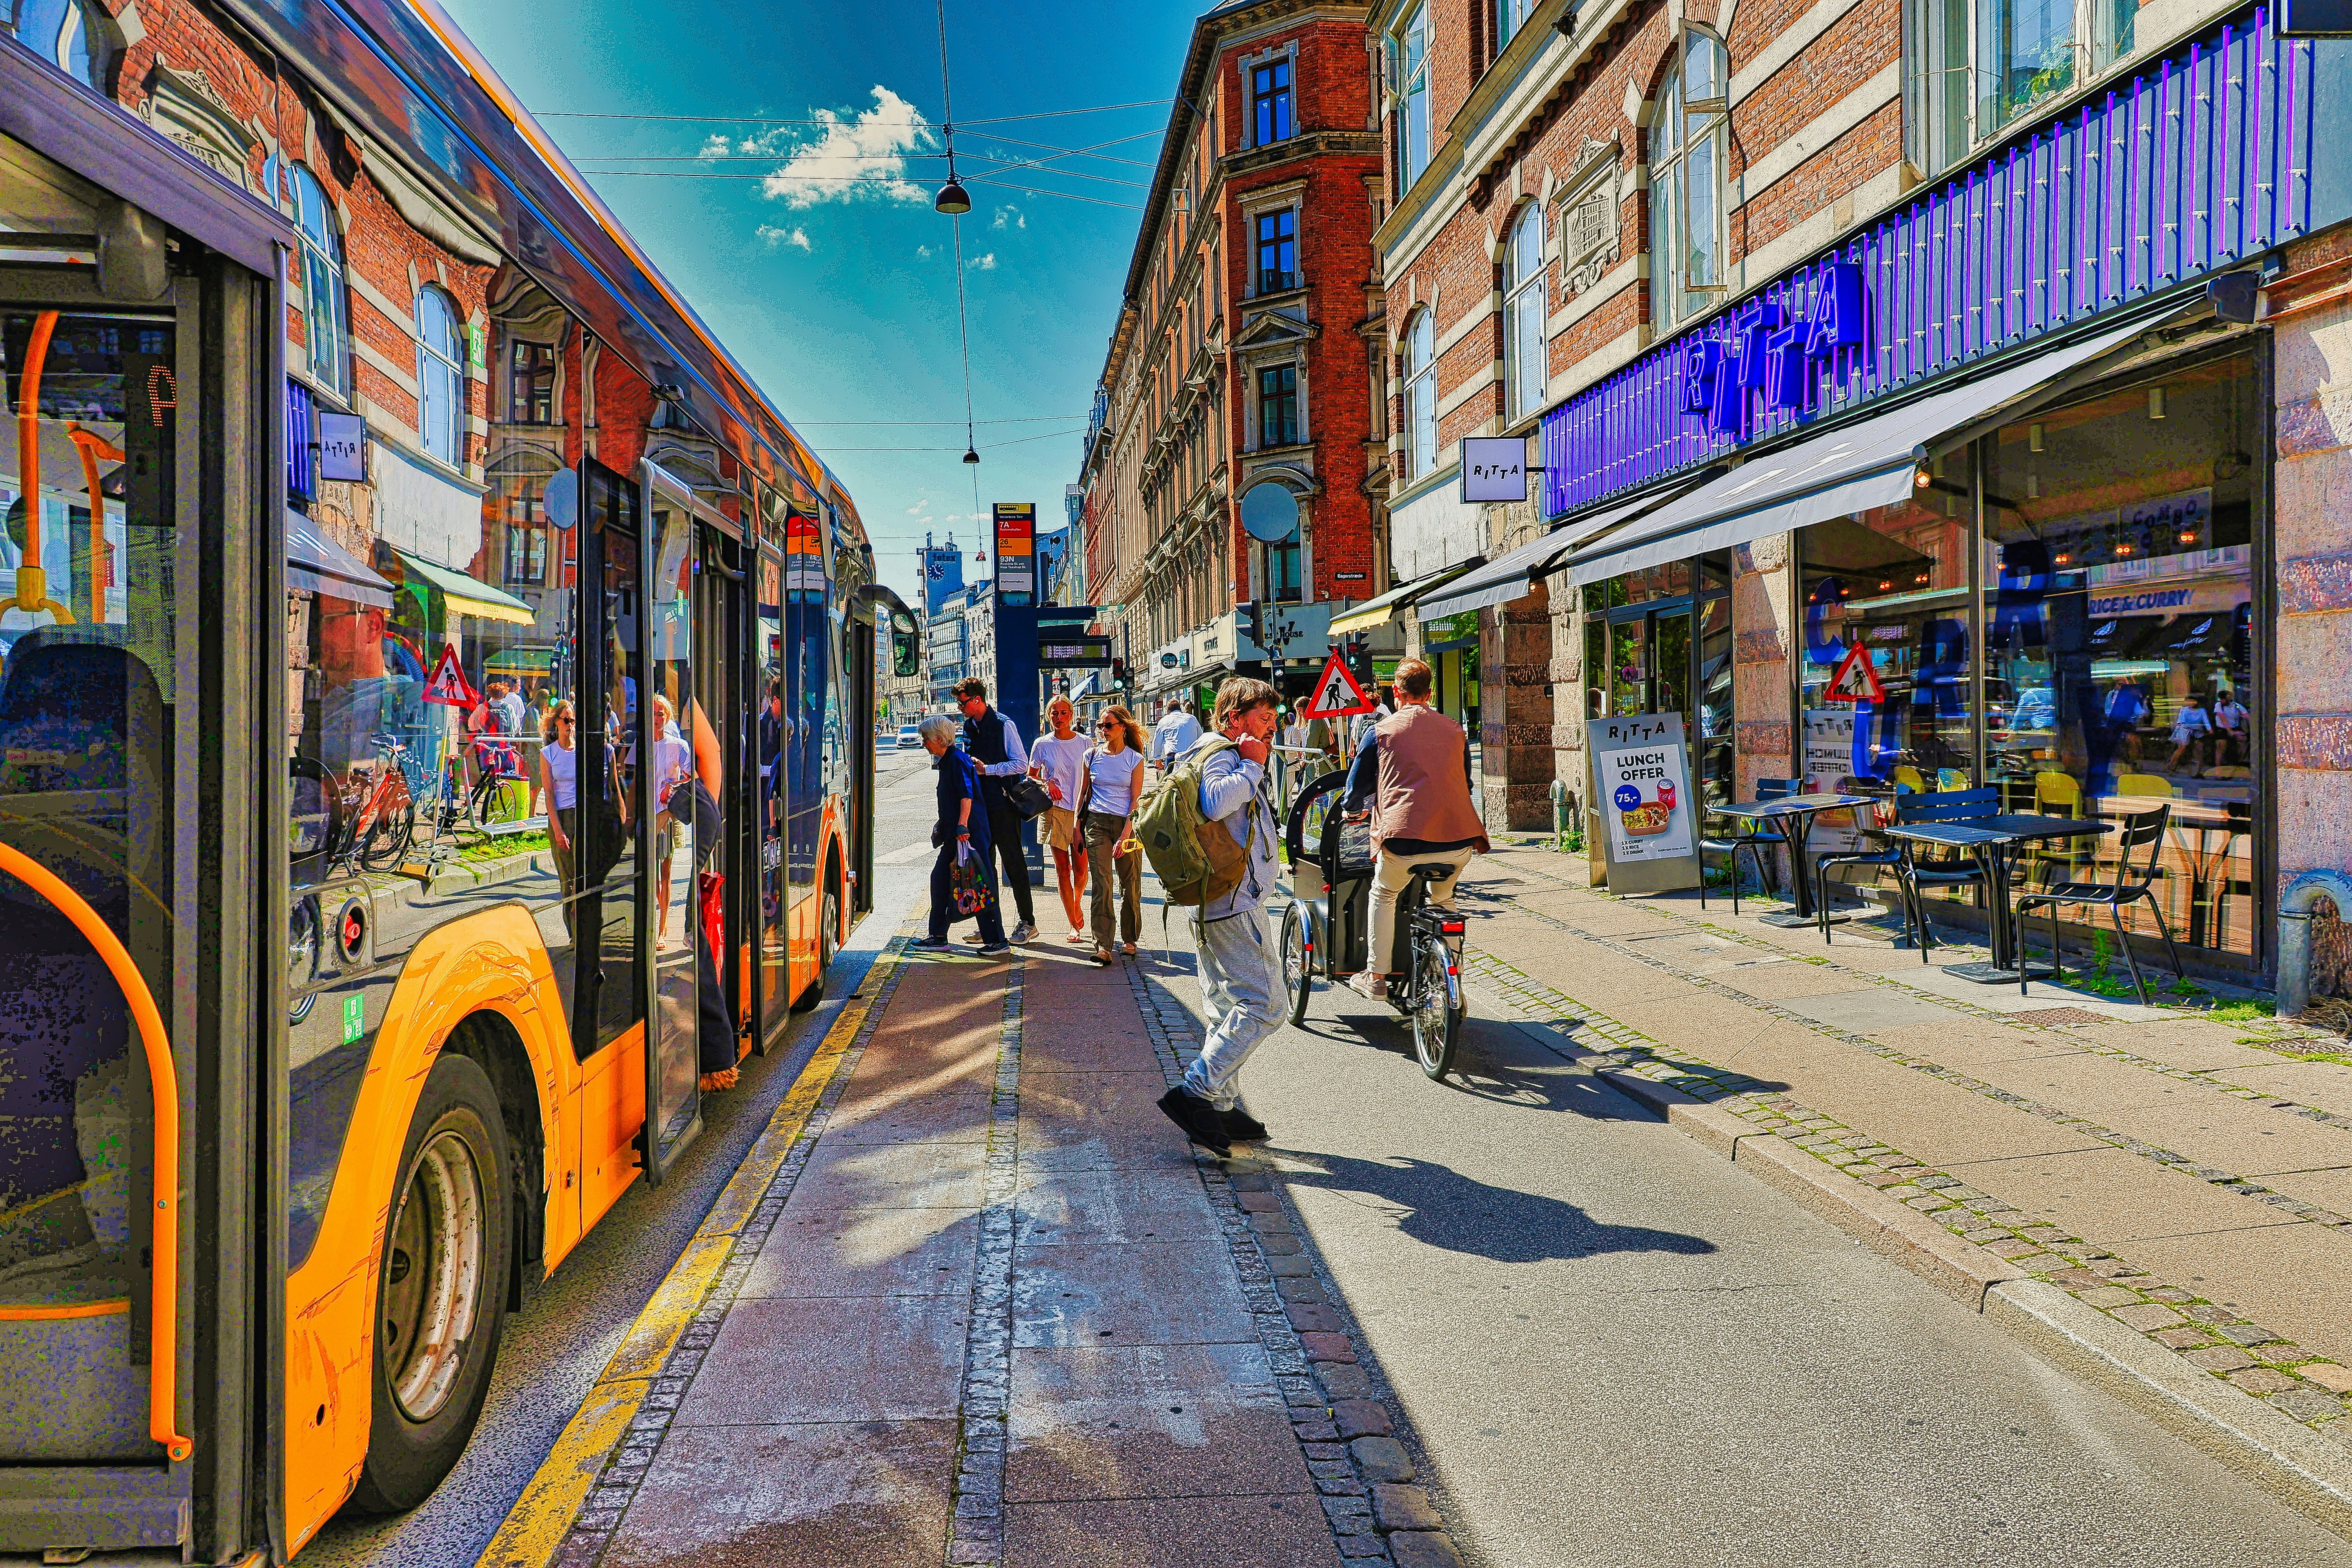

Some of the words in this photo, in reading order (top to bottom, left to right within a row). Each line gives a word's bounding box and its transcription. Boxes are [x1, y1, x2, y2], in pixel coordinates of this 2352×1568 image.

[1681, 263, 1850, 431] RITTA
[1474, 464, 1519, 479] RITTA
[1609, 721, 1665, 743] RITTA
[1616, 753, 1665, 768] LUNCH
[1621, 767, 1665, 781] OFFER
[1617, 794, 1637, 803] 75,-
